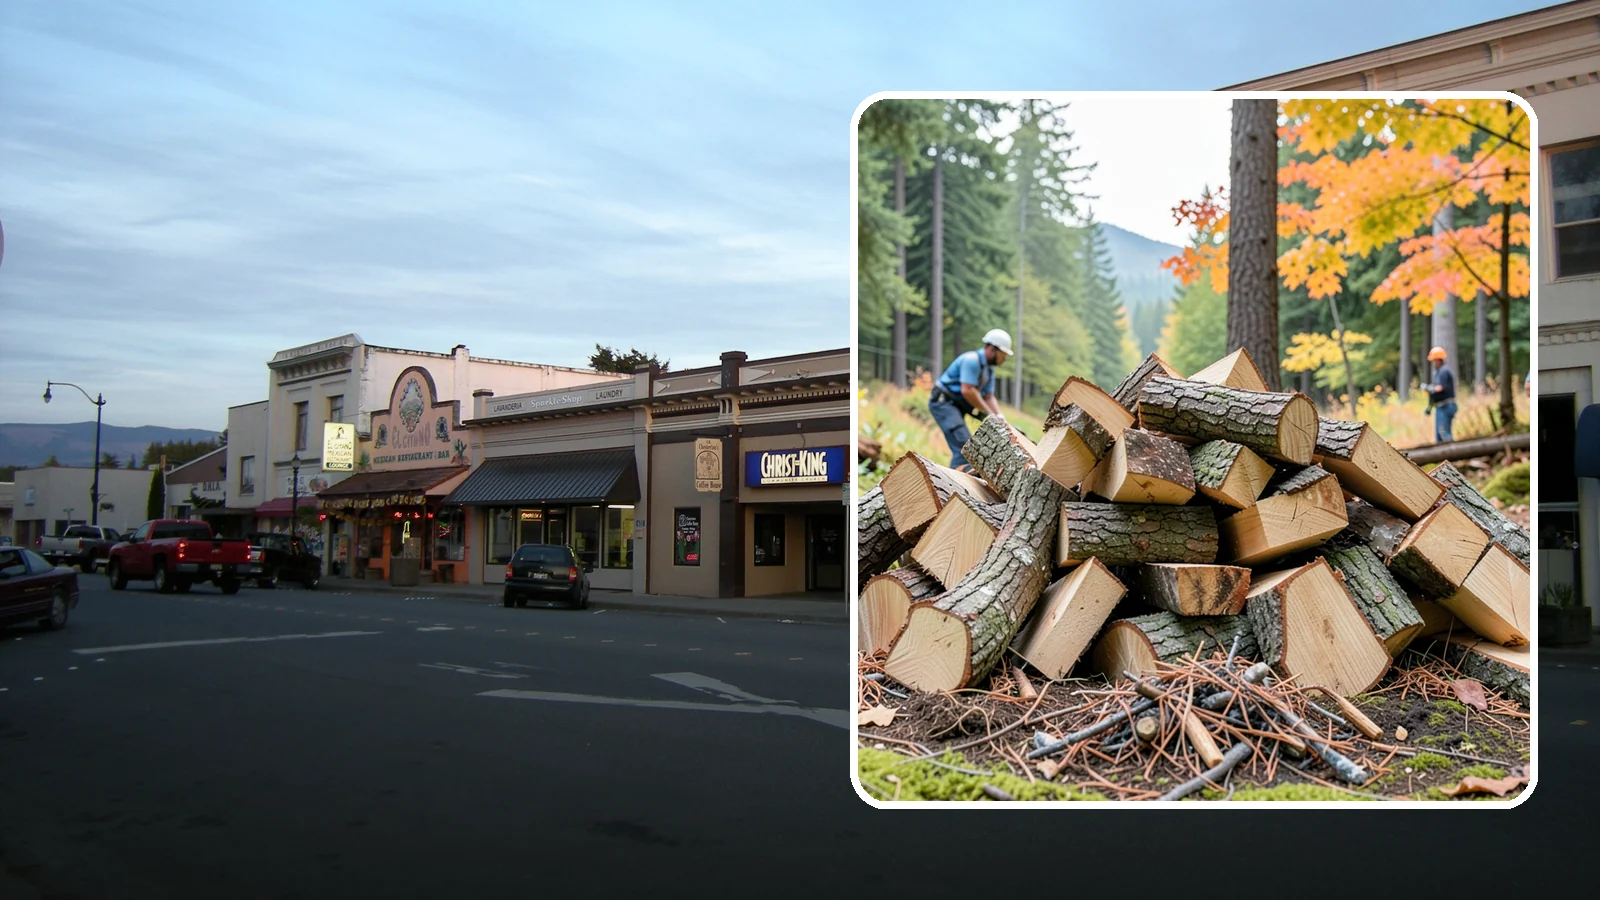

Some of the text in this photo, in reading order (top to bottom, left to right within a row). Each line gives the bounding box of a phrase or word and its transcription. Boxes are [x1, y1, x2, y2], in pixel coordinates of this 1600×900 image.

[531, 394, 582, 409] Sparkle Shop
[595, 389, 623, 399] LAUNDRY
[493, 402, 522, 413] LAVANDERIA
[392, 425, 402, 449] EL
[373, 455, 396, 465] MEXICAN
[397, 452, 433, 463] RESTAURANT
[437, 450, 449, 459] BAR
